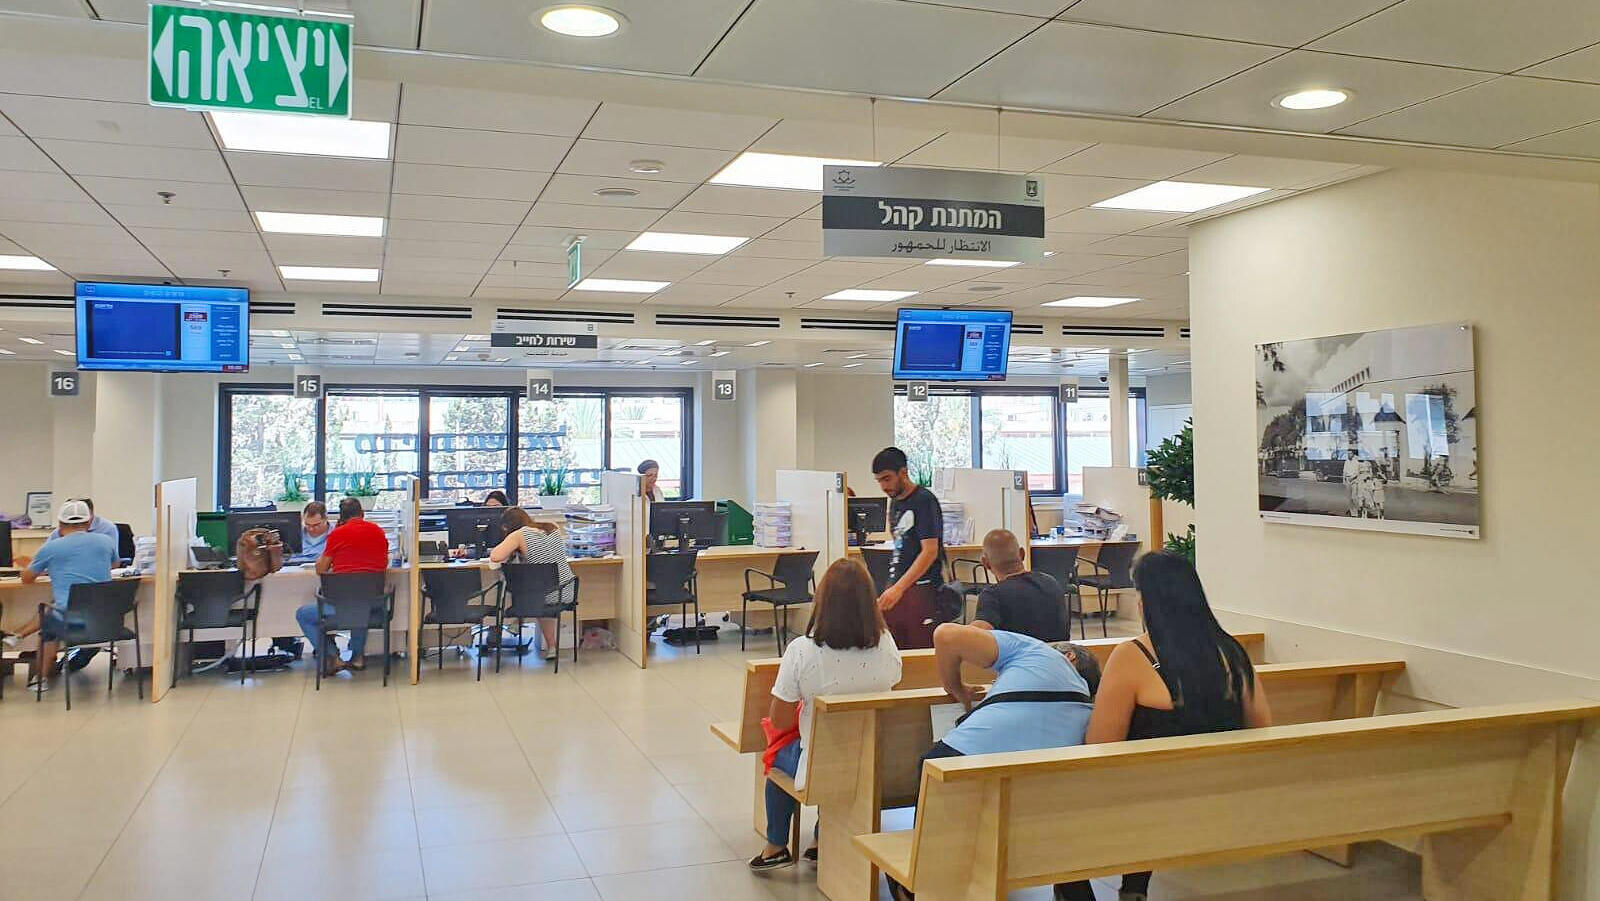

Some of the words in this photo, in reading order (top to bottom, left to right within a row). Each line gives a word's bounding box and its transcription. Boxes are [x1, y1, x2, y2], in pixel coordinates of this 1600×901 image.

[178, 15, 325, 107] יציאה
[308, 96, 324, 109] EL
[878, 200, 924, 230] קהל
[930, 206, 1002, 230] המתנת
[515, 334, 544, 346] לחייב
[545, 335, 576, 346] שירות
[54, 377, 75, 390] 16
[300, 379, 317, 392] 15
[532, 383, 549, 395] 14
[717, 383, 732, 395] 13
[912, 385, 926, 396] 12
[1065, 387, 1076, 398] 11
